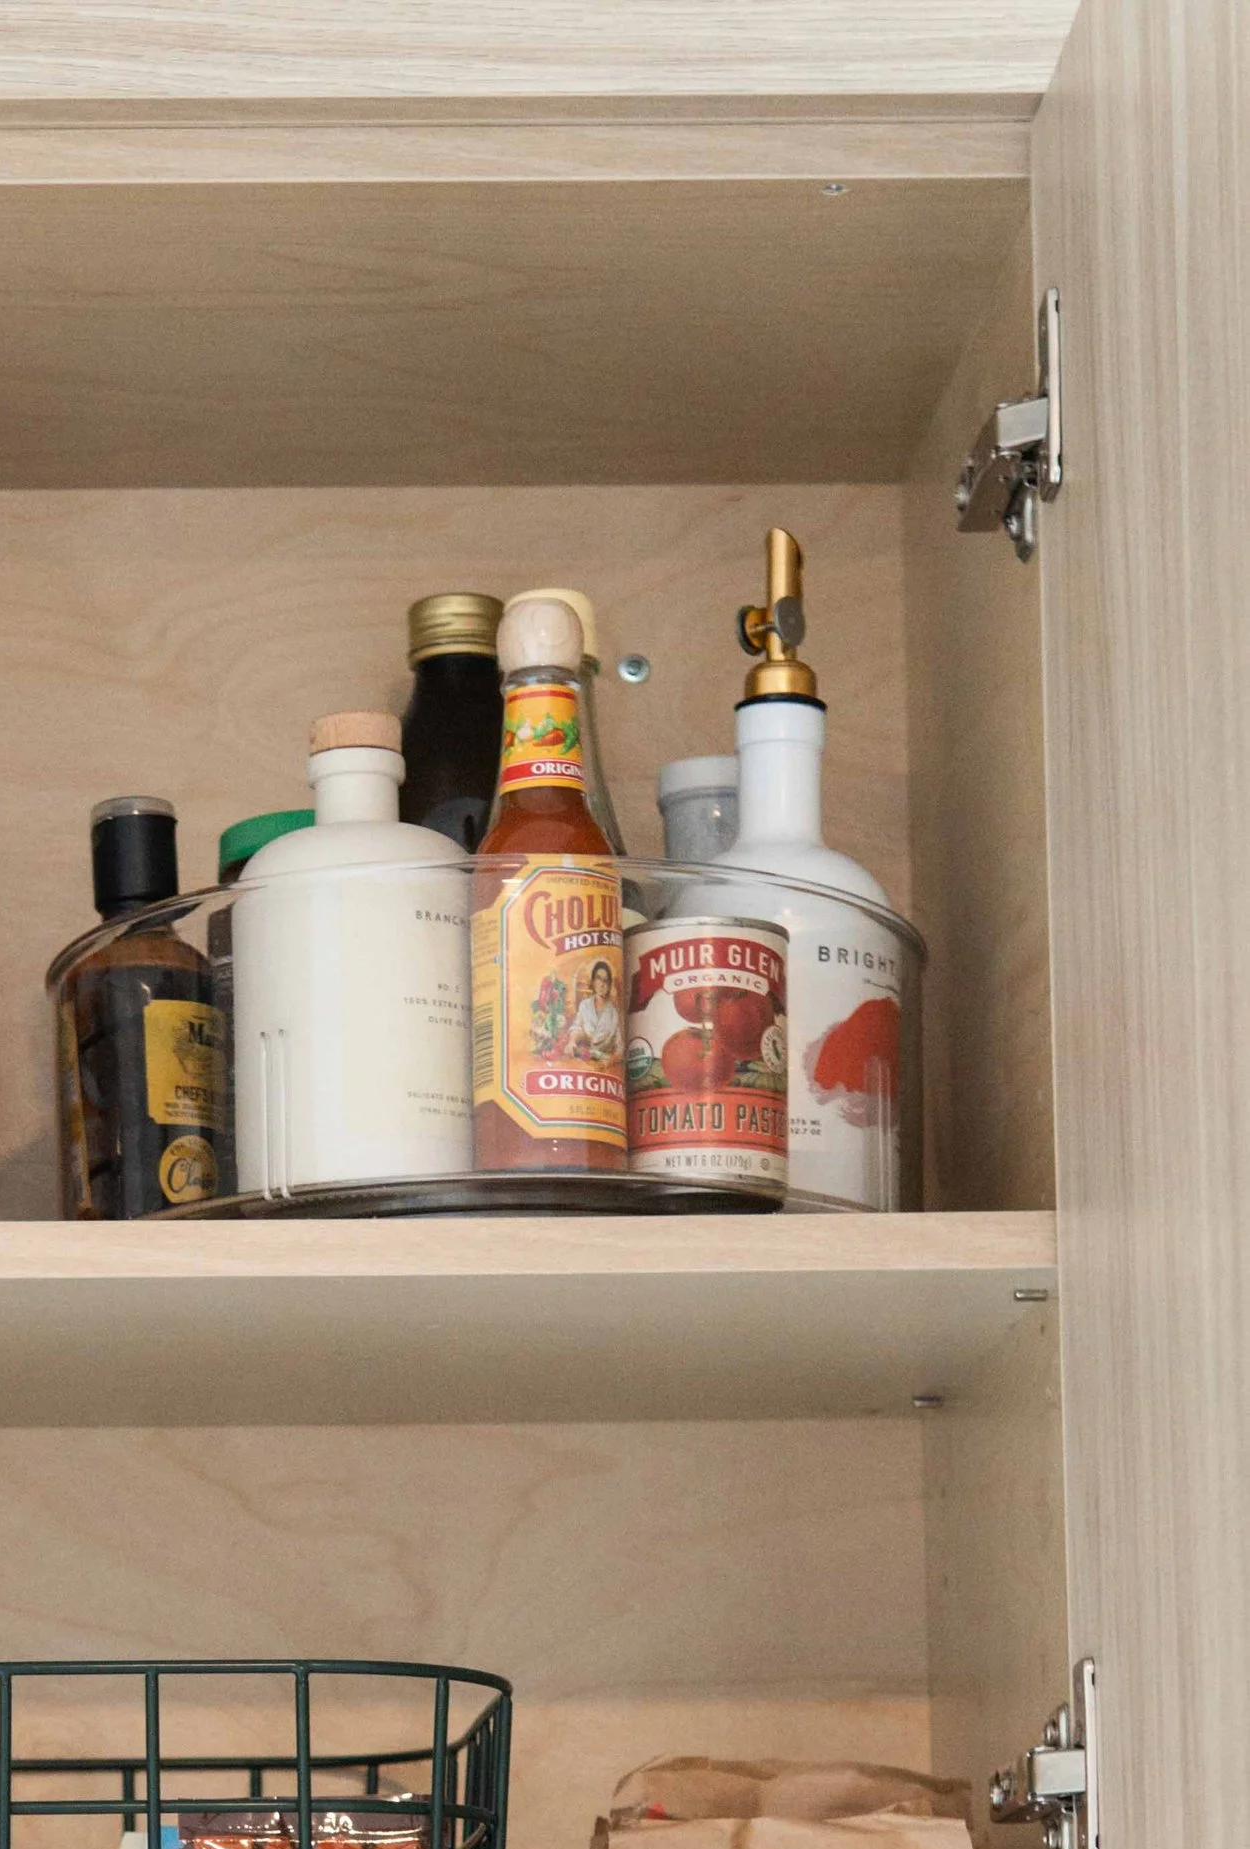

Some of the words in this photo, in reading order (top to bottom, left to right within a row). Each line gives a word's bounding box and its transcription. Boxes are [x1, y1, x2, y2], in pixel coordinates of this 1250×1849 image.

[564, 932, 600, 951] HOT
[650, 943, 714, 980] MUIR
[727, 943, 780, 984] GLEN
[673, 973, 763, 990] ORGANIC
[638, 1102, 725, 1138] TOMATO
[736, 1103, 787, 1139] PASTE
[665, 1157, 682, 1168] NET
[684, 1155, 698, 1167] WT
[701, 1155, 707, 1166] 6
[710, 1155, 724, 1168] OZ
